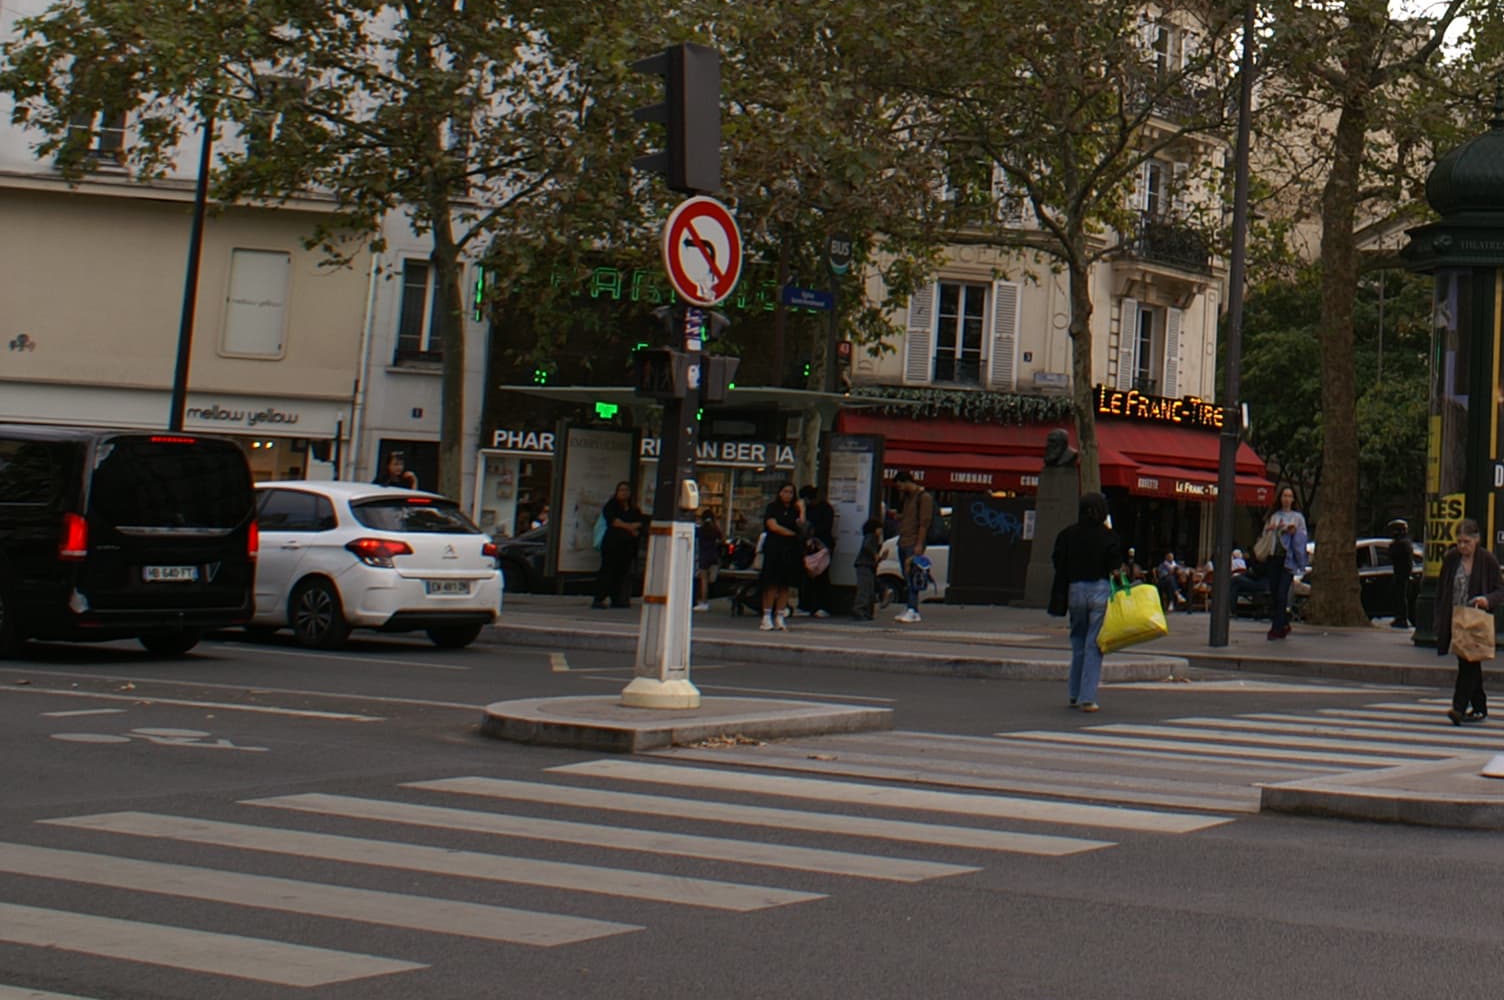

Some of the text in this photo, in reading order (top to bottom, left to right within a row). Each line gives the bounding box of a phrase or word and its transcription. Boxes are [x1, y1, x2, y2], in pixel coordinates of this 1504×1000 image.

[831, 241, 850, 256] BUS
[1099, 384, 1123, 415] LE
[187, 405, 299, 427] mellow yellow
